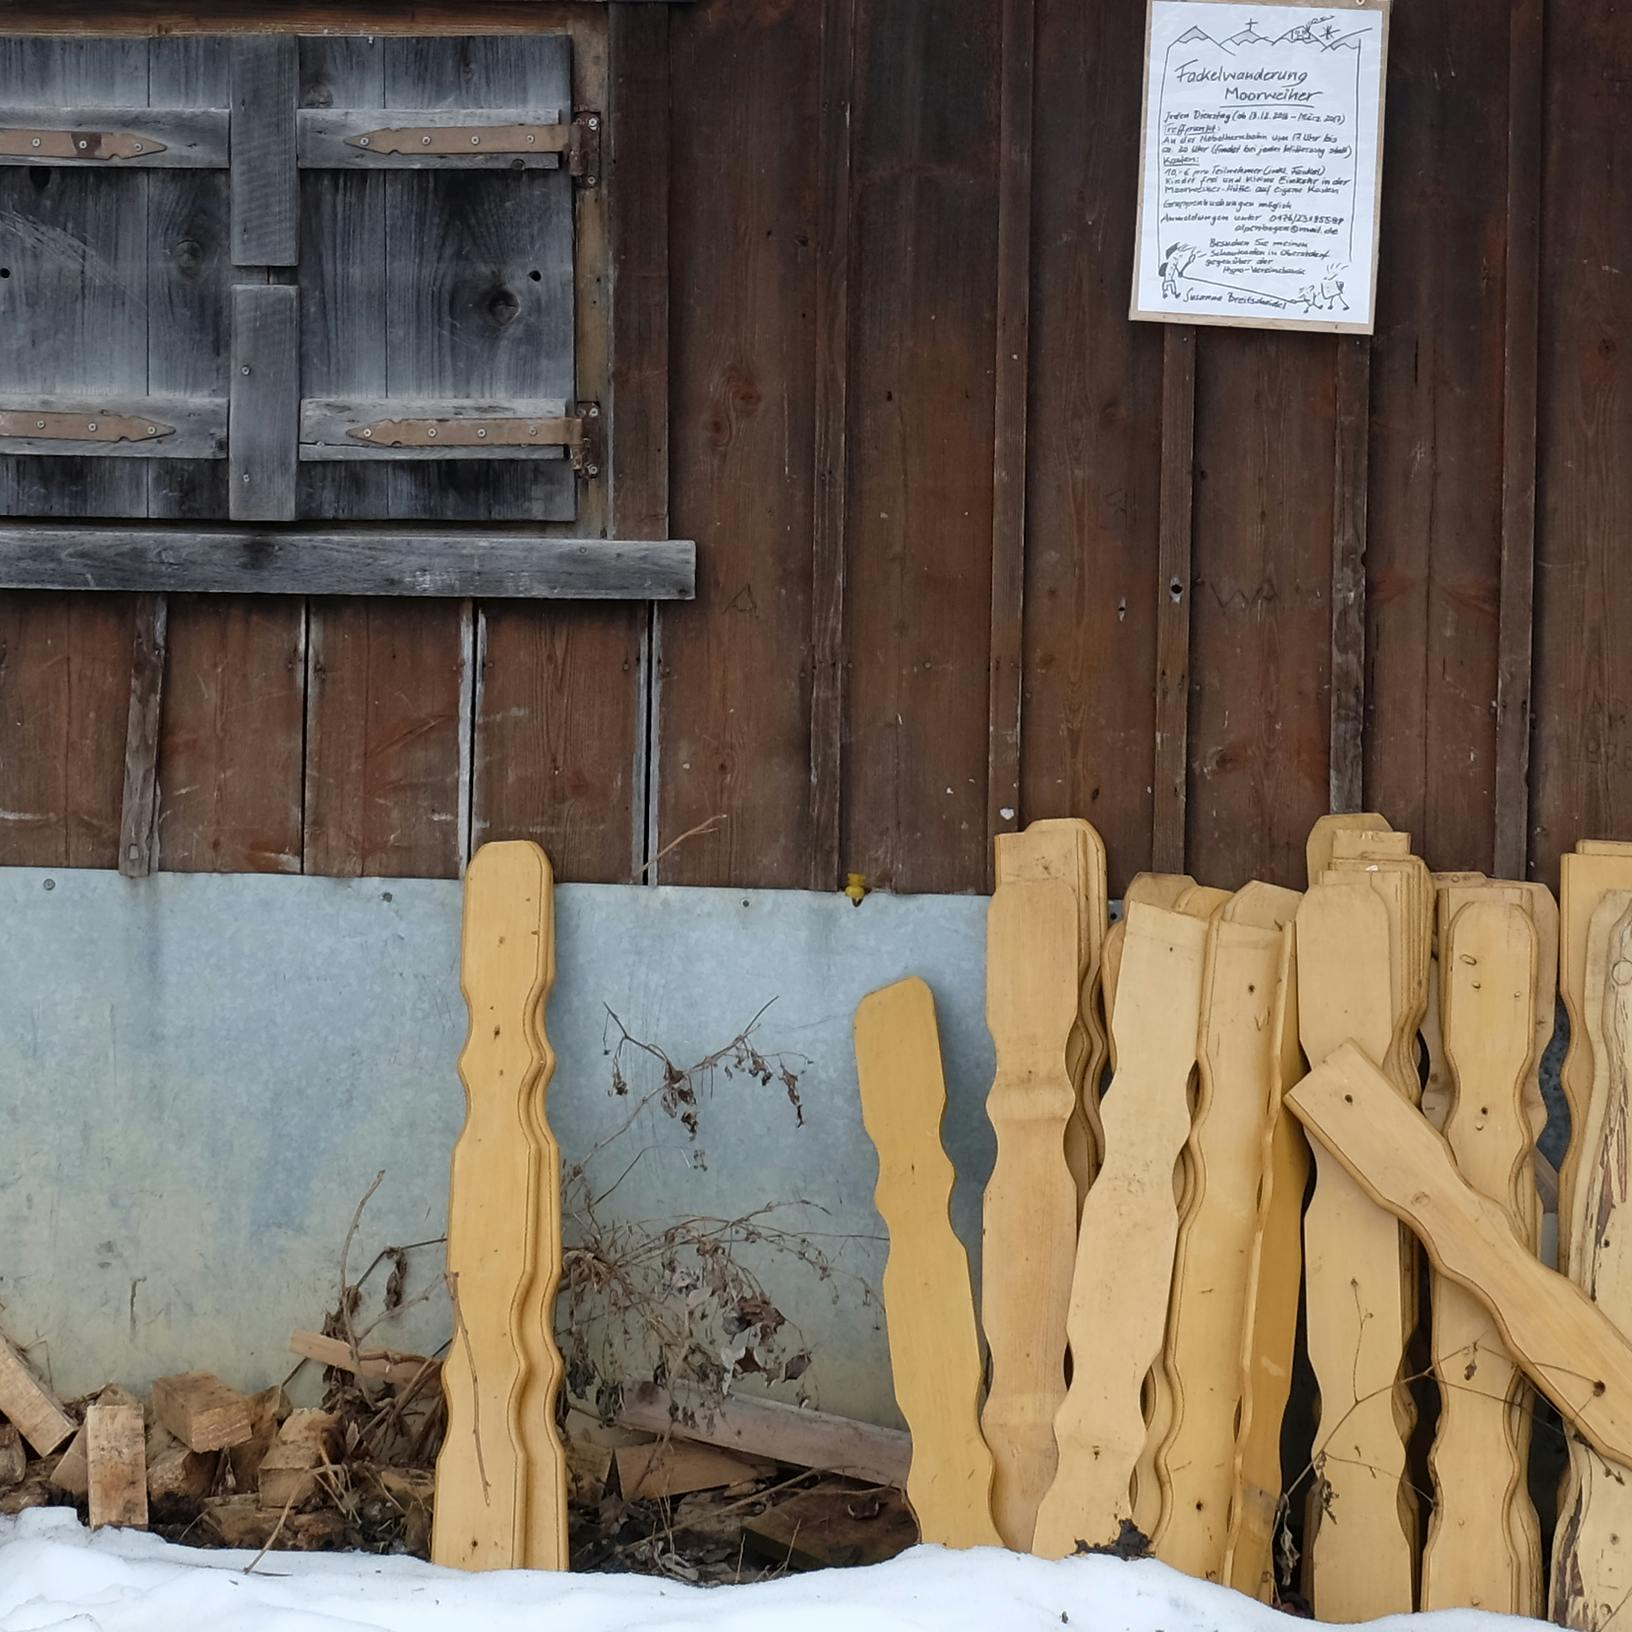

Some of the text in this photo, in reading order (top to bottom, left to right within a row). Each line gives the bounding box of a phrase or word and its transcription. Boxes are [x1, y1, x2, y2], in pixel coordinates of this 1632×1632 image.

[1174, 59, 1308, 87] Fackelwanderung
[1224, 87, 1324, 103] Moorweiher
[1161, 137, 1177, 145] An
[1179, 136, 1196, 145] der
[1323, 133, 1338, 144] bis
[1331, 176, 1352, 186] der
